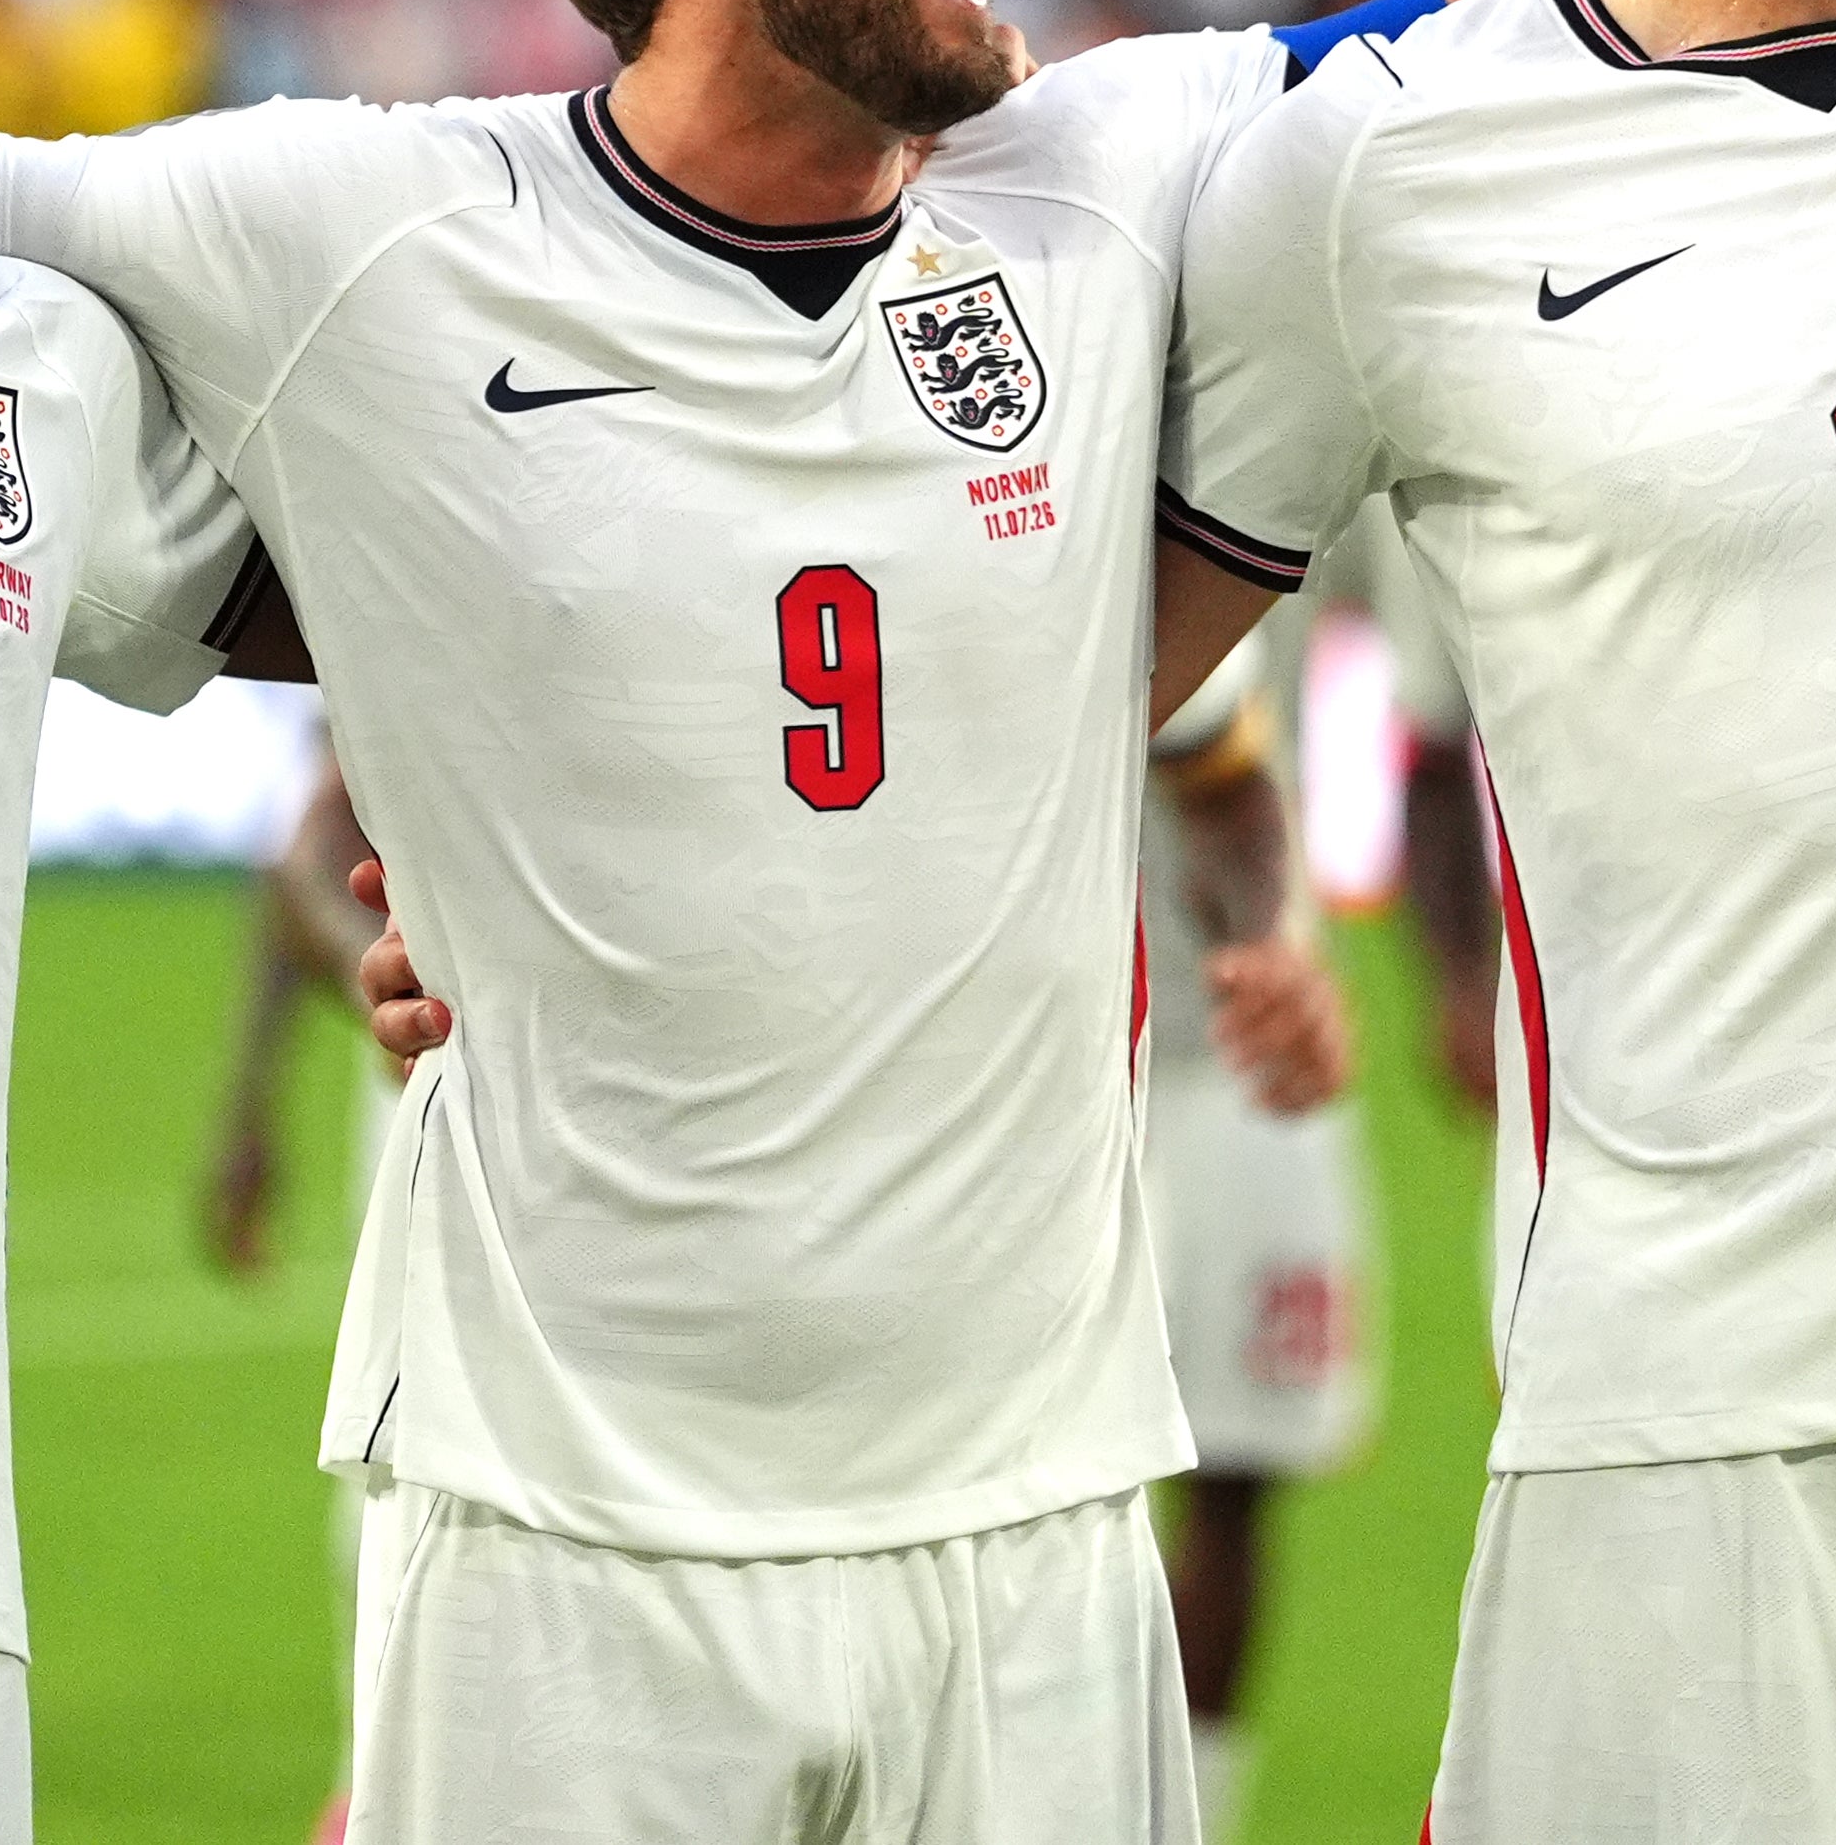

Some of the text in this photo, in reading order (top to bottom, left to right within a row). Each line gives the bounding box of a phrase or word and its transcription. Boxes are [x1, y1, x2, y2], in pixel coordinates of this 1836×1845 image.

[966, 461, 1050, 506] NORWAY
[984, 500, 1056, 541] 11.07.26
[775, 563, 885, 813] 9
